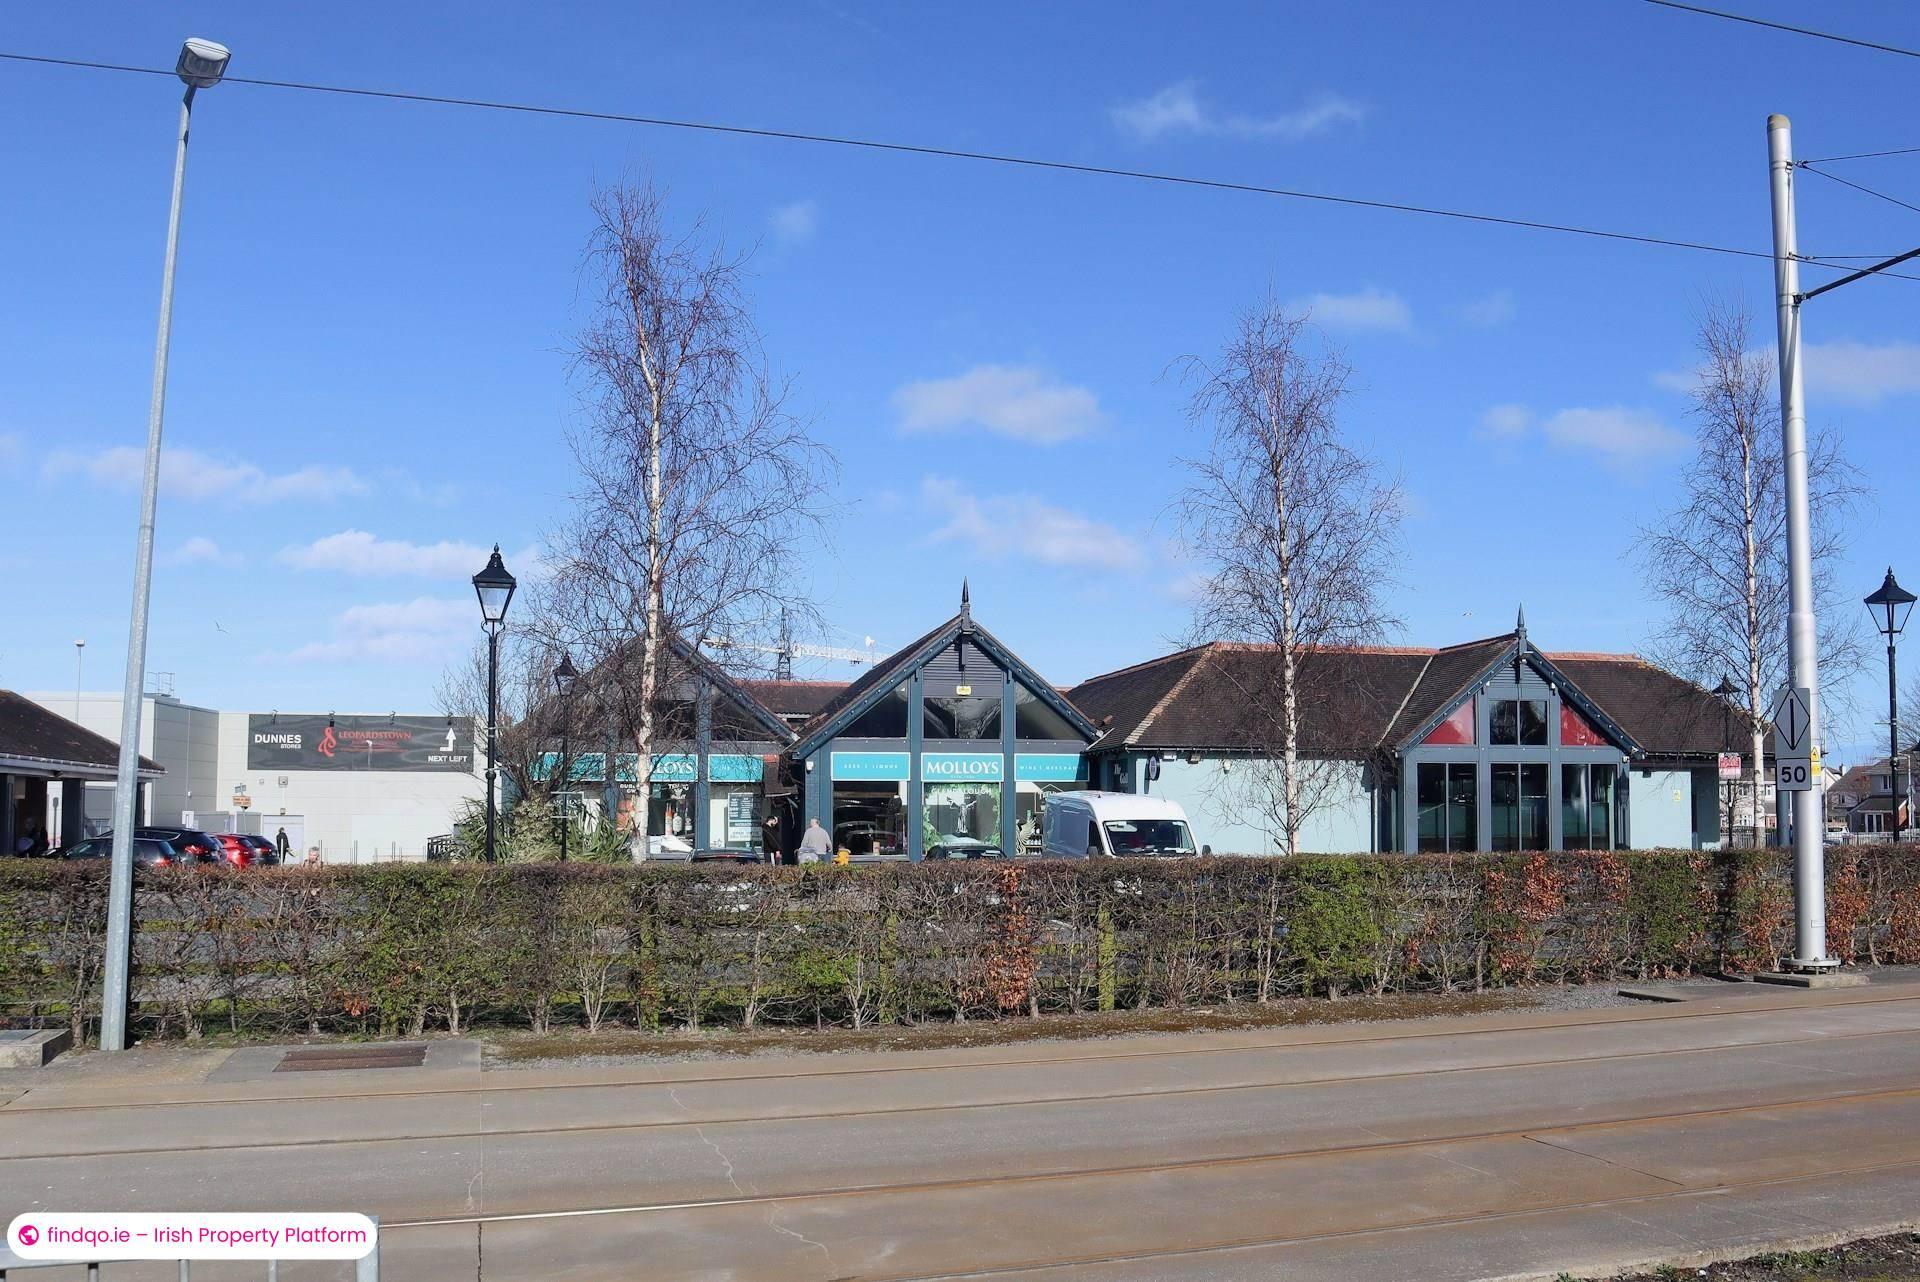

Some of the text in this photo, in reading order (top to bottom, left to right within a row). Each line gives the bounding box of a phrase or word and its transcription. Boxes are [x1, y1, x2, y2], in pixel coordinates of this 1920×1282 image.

[254, 733, 302, 744] DUNNES
[338, 730, 412, 739] LEOPARDSTOWN
[427, 755, 468, 763] NEXT LEFT
[926, 761, 999, 775] MOLLOYS
[1781, 765, 1806, 783] 50
